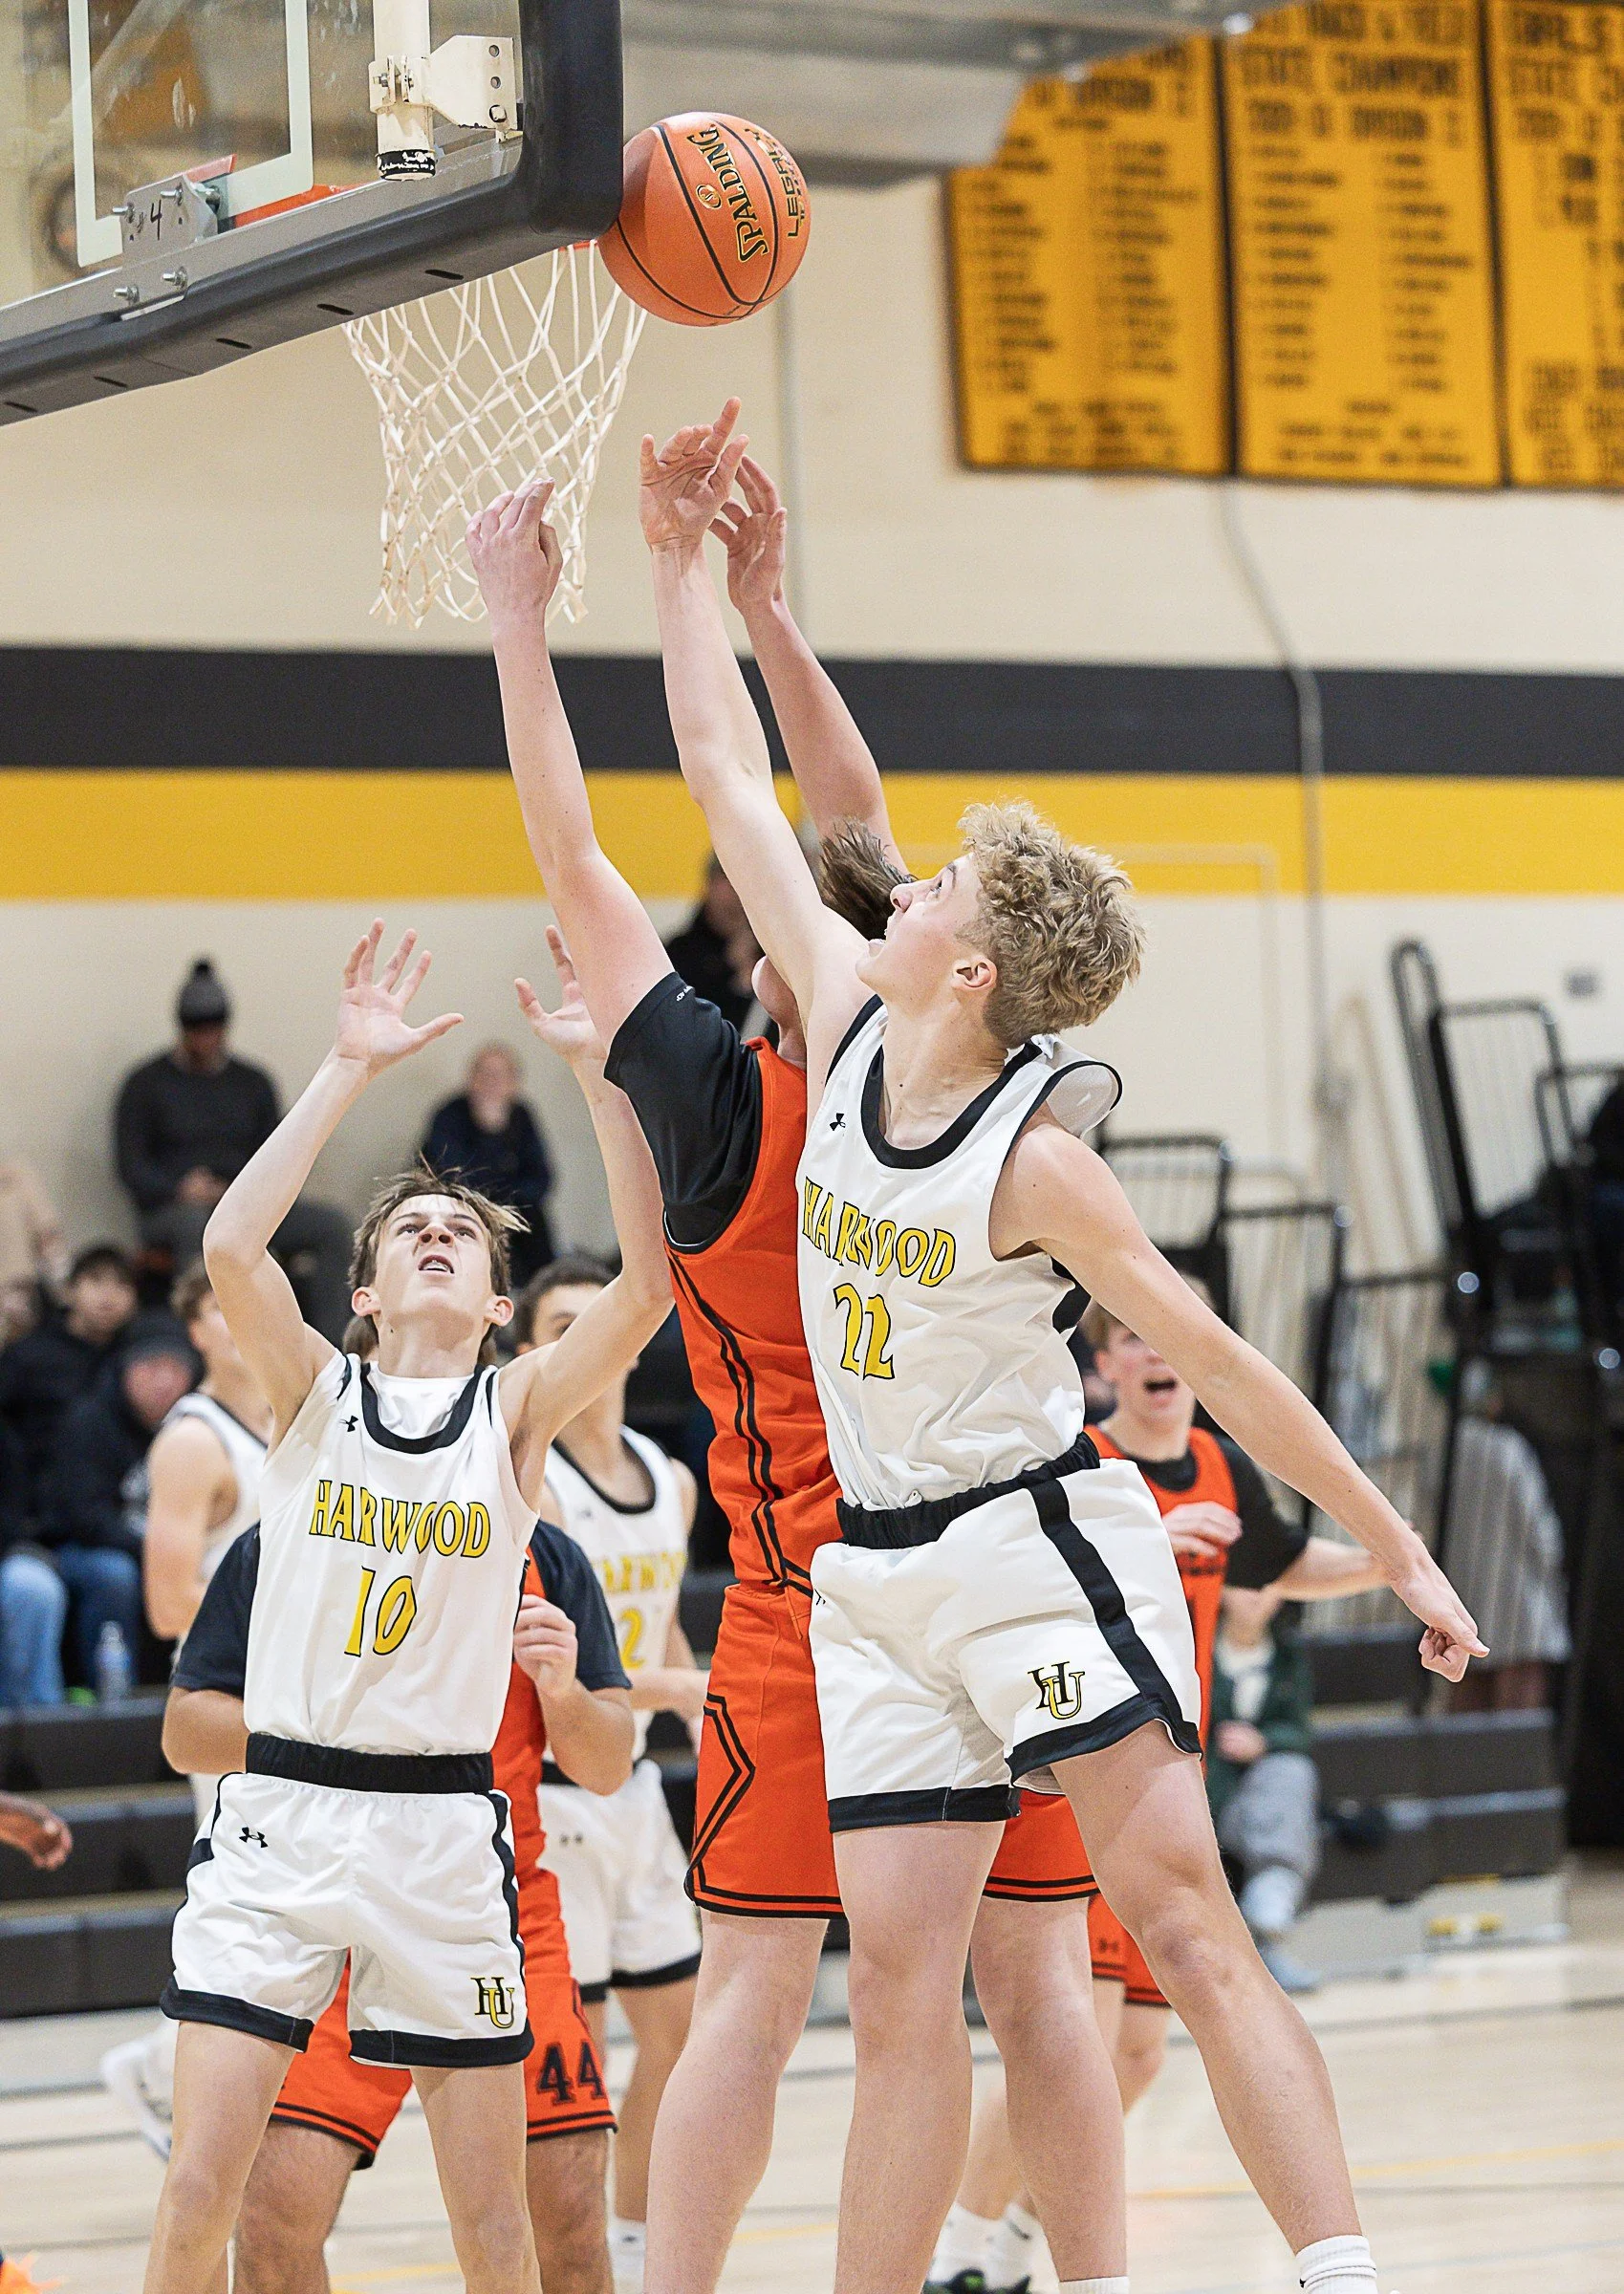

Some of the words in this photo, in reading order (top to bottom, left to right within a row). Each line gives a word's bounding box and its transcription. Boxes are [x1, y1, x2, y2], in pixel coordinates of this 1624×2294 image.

[150, 199, 162, 241] 4
[686, 123, 769, 263] SPALDING
[802, 1176, 956, 1288] HARWOOD
[833, 1283, 895, 1380] 22
[309, 1480, 491, 1558] HARWOOD
[344, 1566, 417, 1657] 10
[536, 2041, 607, 2106] 44
